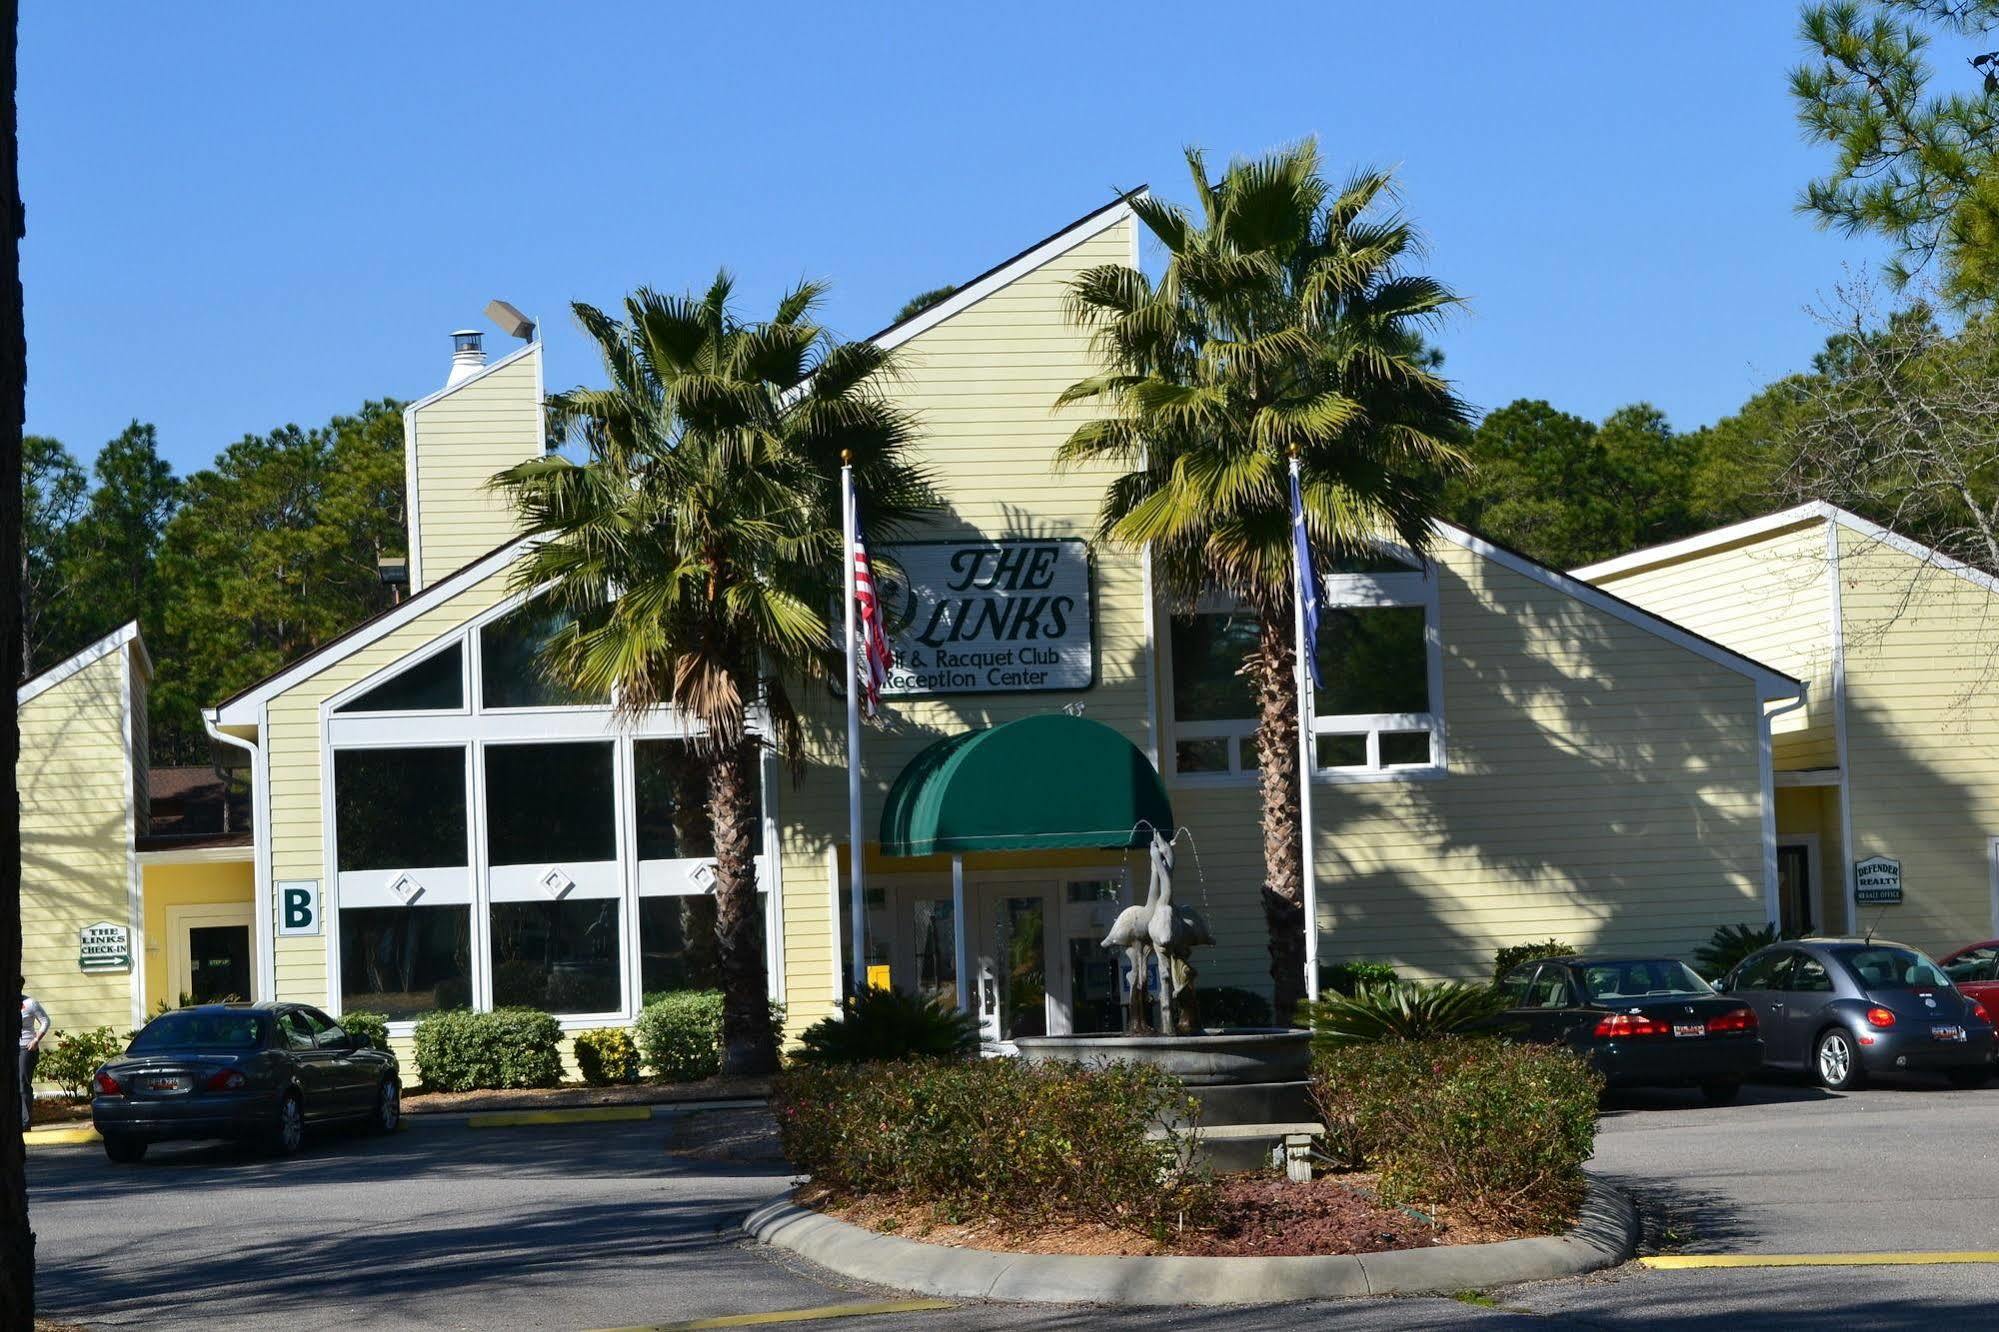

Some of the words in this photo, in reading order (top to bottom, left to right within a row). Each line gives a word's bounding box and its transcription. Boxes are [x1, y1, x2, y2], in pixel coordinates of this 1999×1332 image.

[947, 547, 1060, 592] THE
[915, 595, 1074, 648] LINKS
[911, 650, 928, 668] &
[936, 649, 1014, 669] Racquet
[1018, 647, 1060, 665] Club
[987, 668, 1048, 686] Center
[1858, 863, 1898, 877] DEFENDER
[1860, 877, 1898, 885] REALTY
[1880, 889, 1900, 897] OFFICE
[284, 888, 313, 928] B
[82, 935, 125, 943] LINKS
[81, 945, 127, 953] CHECK-IN
